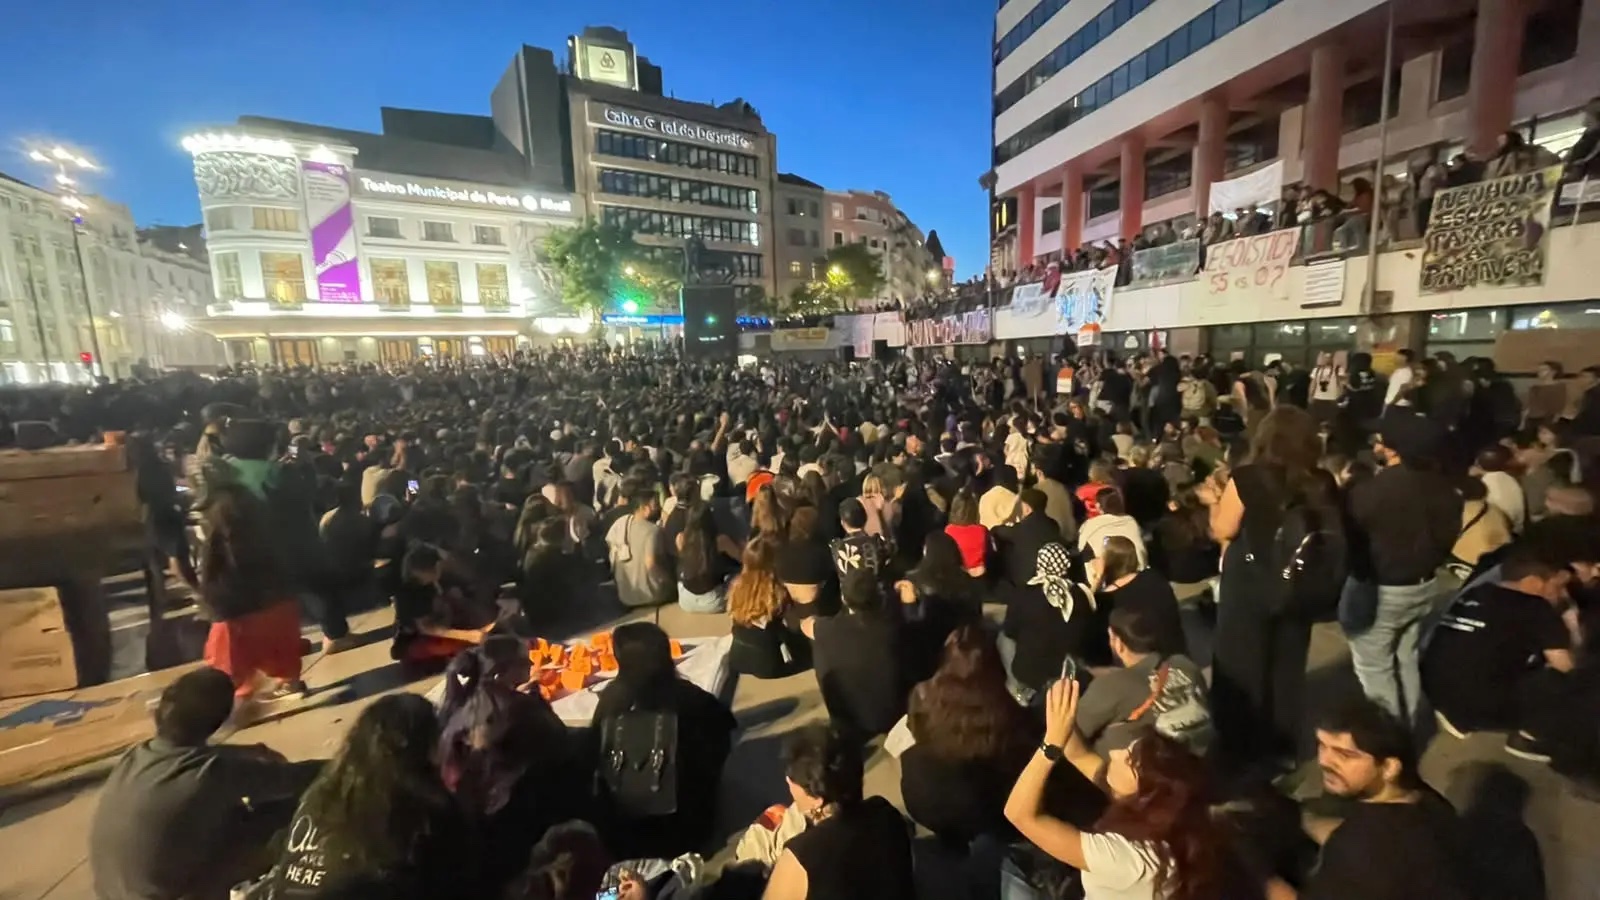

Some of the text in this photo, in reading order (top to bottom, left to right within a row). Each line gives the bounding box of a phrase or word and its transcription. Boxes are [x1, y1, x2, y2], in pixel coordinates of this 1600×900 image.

[360, 177, 406, 195] Teatro
[406, 182, 469, 201] Municipal
[285, 864, 326, 886] HERE
